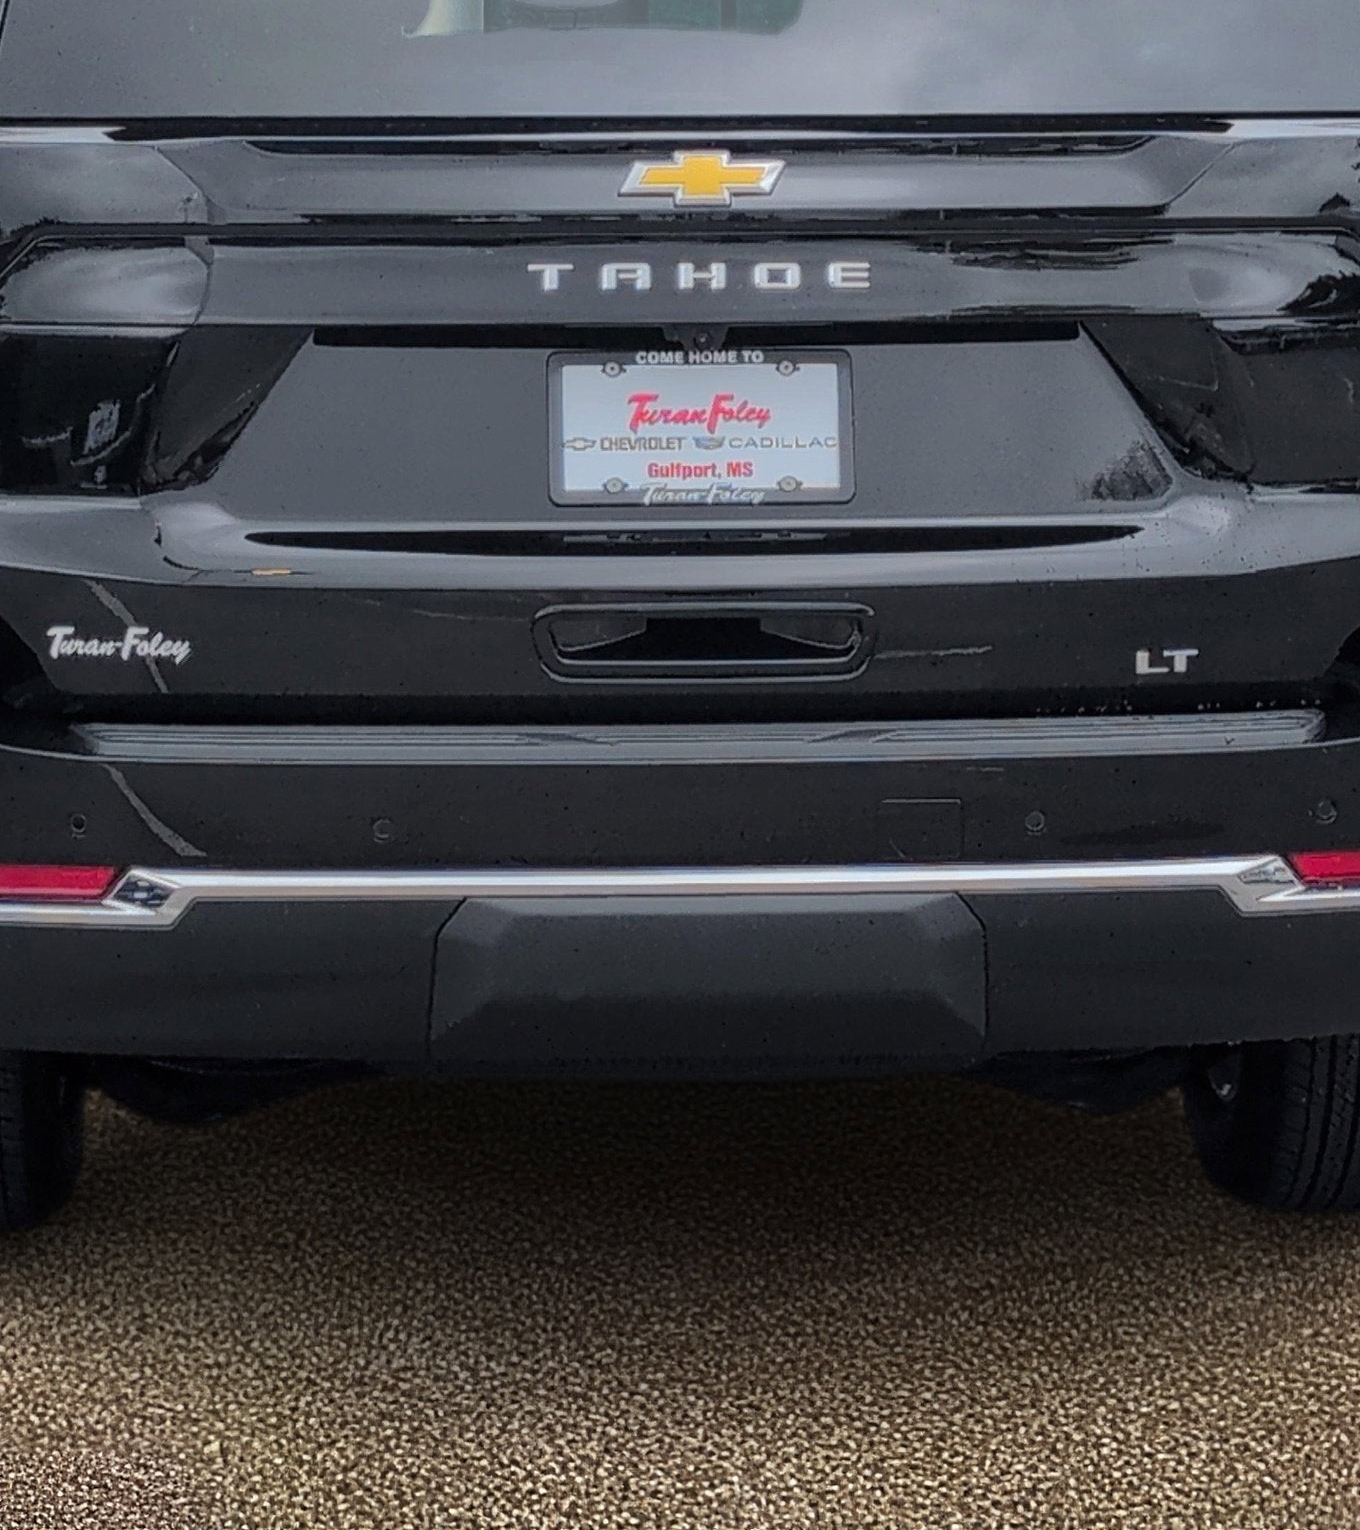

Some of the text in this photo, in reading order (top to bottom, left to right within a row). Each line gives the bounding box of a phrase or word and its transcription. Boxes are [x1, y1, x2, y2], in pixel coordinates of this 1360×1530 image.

[527, 262, 871, 291] TAHOE
[635, 349, 765, 365] COME HOME TO
[600, 436, 838, 451] CHEVROLET CADILLAC
[647, 461, 754, 480] Gulfport, MS
[1135, 649, 1199, 674] LT
